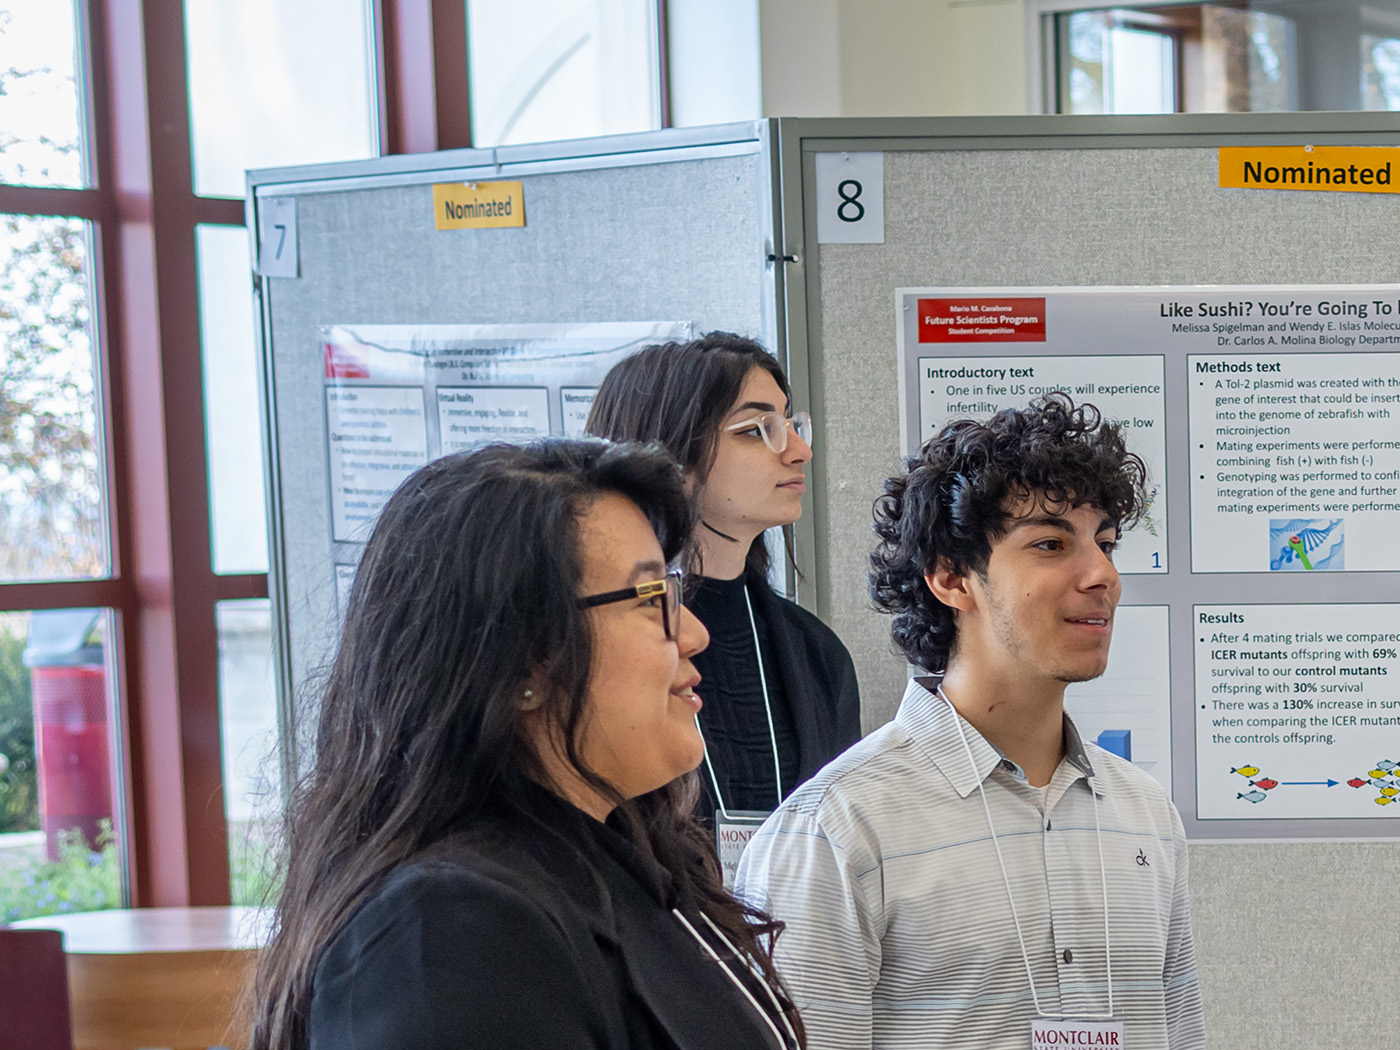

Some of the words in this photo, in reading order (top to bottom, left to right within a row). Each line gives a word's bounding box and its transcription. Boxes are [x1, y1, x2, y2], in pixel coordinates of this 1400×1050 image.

[1243, 161, 1391, 186] Nominated
[837, 179, 865, 223] 8
[445, 195, 513, 221] Nominated
[273, 224, 286, 261] 7
[1160, 302, 1193, 317] Like
[1198, 301, 1253, 317] Sushi?
[1318, 300, 1368, 318] Going
[1372, 301, 1392, 315] To
[925, 316, 955, 325] Future
[956, 315, 998, 325] Scientists
[999, 315, 1038, 326] Program
[948, 327, 974, 335] Student
[974, 327, 1015, 335] Competition
[1172, 323, 1210, 333] Melissa
[1212, 322, 1265, 334] Spigelman
[1267, 322, 1286, 332] and
[1289, 321, 1325, 333] Wendy
[1327, 321, 1336, 331] E.
[1339, 321, 1361, 331] Islas
[1217, 336, 1231, 346] Dr.
[1234, 335, 1265, 346] Carlos
[1267, 336, 1278, 345] A.
[1281, 335, 1316, 345] Molina
[1319, 335, 1356, 347] Biology
[927, 366, 1006, 380] Introductory
[1009, 367, 1034, 378] text
[1196, 361, 1253, 373] Methods
[1256, 362, 1281, 372] text
[946, 385, 970, 396] One
[973, 385, 983, 395] in
[986, 384, 1007, 395] five
[1010, 384, 1026, 395] US
[1075, 383, 1095, 394] will
[1098, 383, 1160, 396] experience
[1215, 379, 1223, 389] A
[1225, 378, 1250, 389] Tol-2
[1253, 378, 1294, 390] plasmid
[1296, 380, 1317, 388] was
[1319, 377, 1359, 388] created
[1361, 377, 1385, 387] with
[947, 402, 998, 414] infertility
[1133, 417, 1154, 428] low
[1216, 425, 1290, 437] microinjection
[1152, 552, 1162, 568] 1
[1199, 612, 1244, 623] Results
[1212, 700, 1244, 710] There
[1247, 701, 1269, 710] was
[1272, 702, 1279, 710] a
[1283, 699, 1314, 710] 130%
[1317, 699, 1364, 709] increase
[1367, 699, 1377, 709] in
[1034, 1030, 1119, 1045] MONTCLAIR
